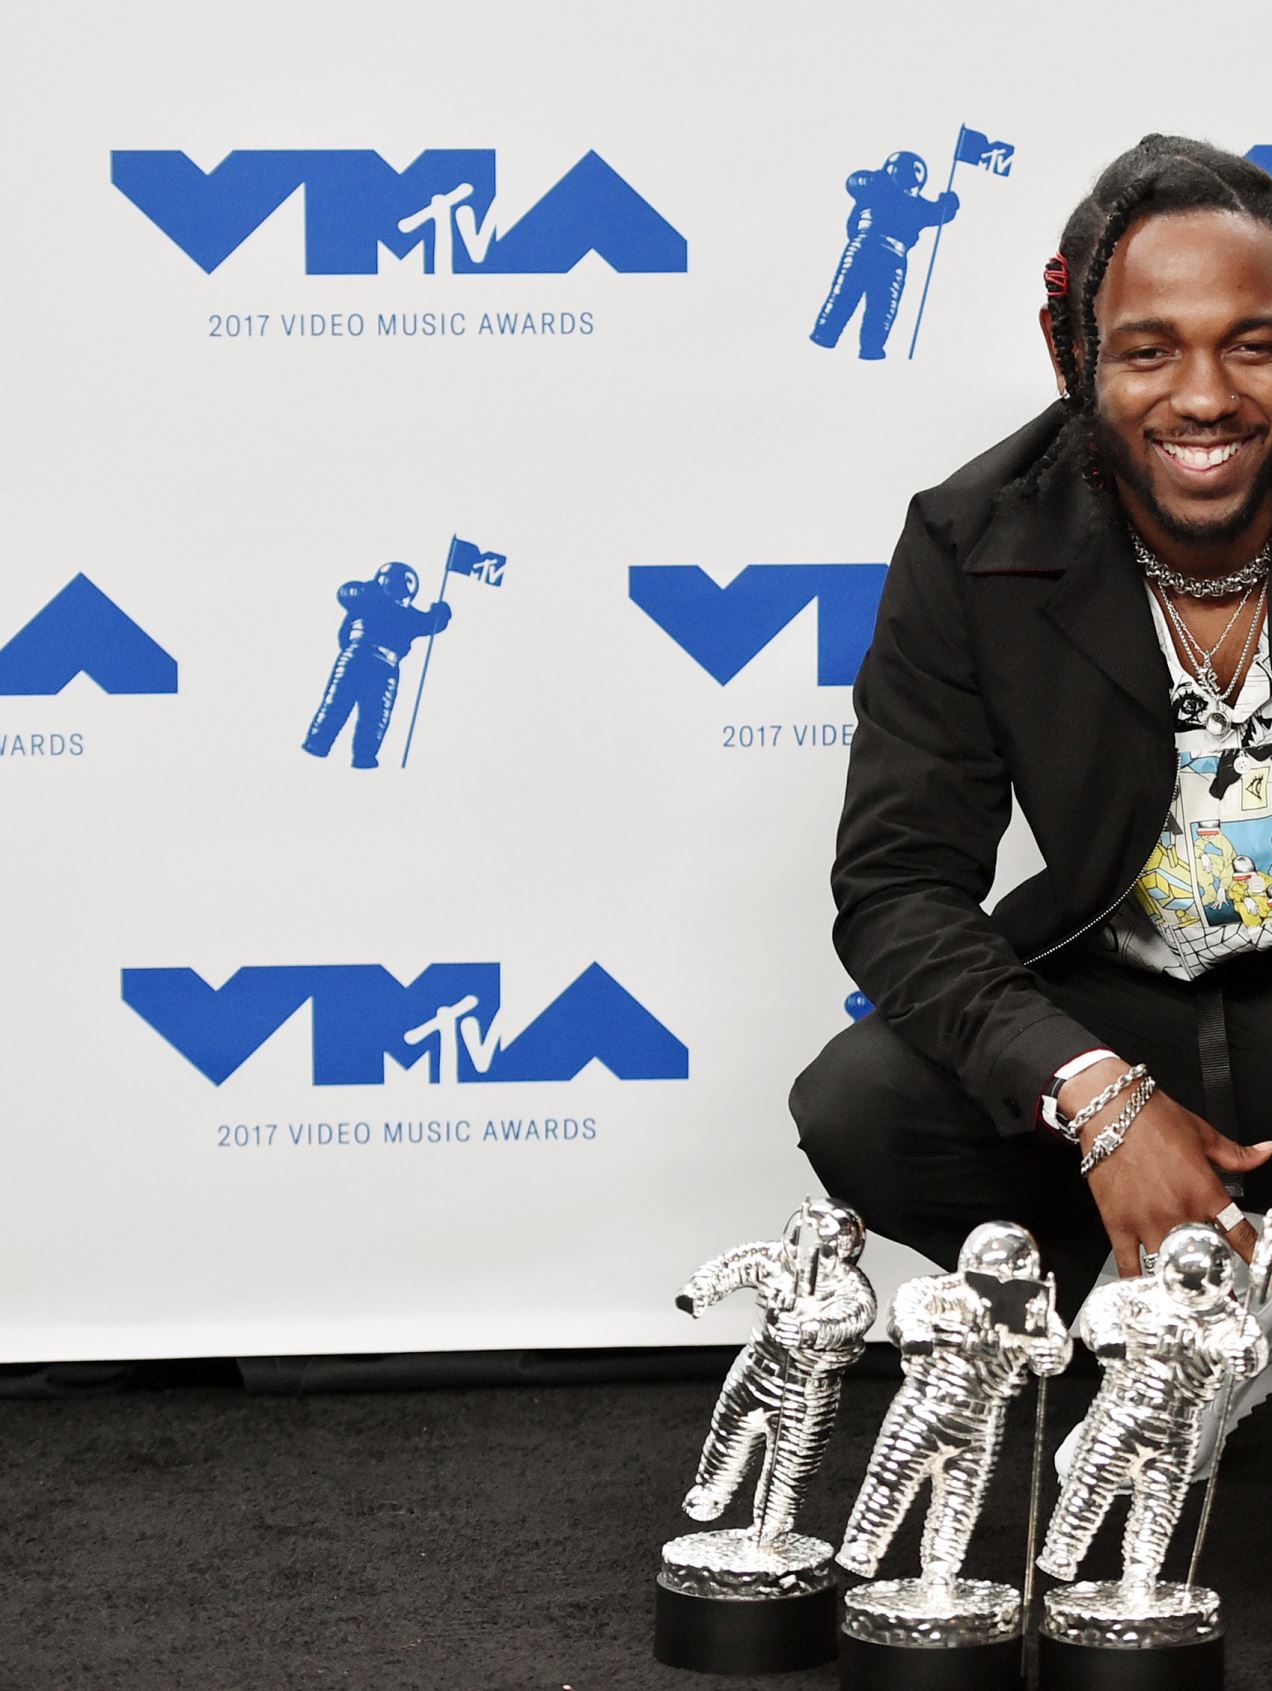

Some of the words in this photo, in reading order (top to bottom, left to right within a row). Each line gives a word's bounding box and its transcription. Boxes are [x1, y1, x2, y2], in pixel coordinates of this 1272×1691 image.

[208, 314, 270, 338] 2017
[280, 312, 365, 337] VIDEO
[377, 312, 466, 337] MUSIC
[478, 311, 595, 336] AWARDS
[722, 724, 783, 748] 2017
[792, 723, 854, 748] VIDE
[217, 1124, 278, 1148] 2017
[288, 1121, 371, 1146] VIDEO
[383, 1119, 471, 1144] MUSIC
[482, 1117, 597, 1142] AWARDS
